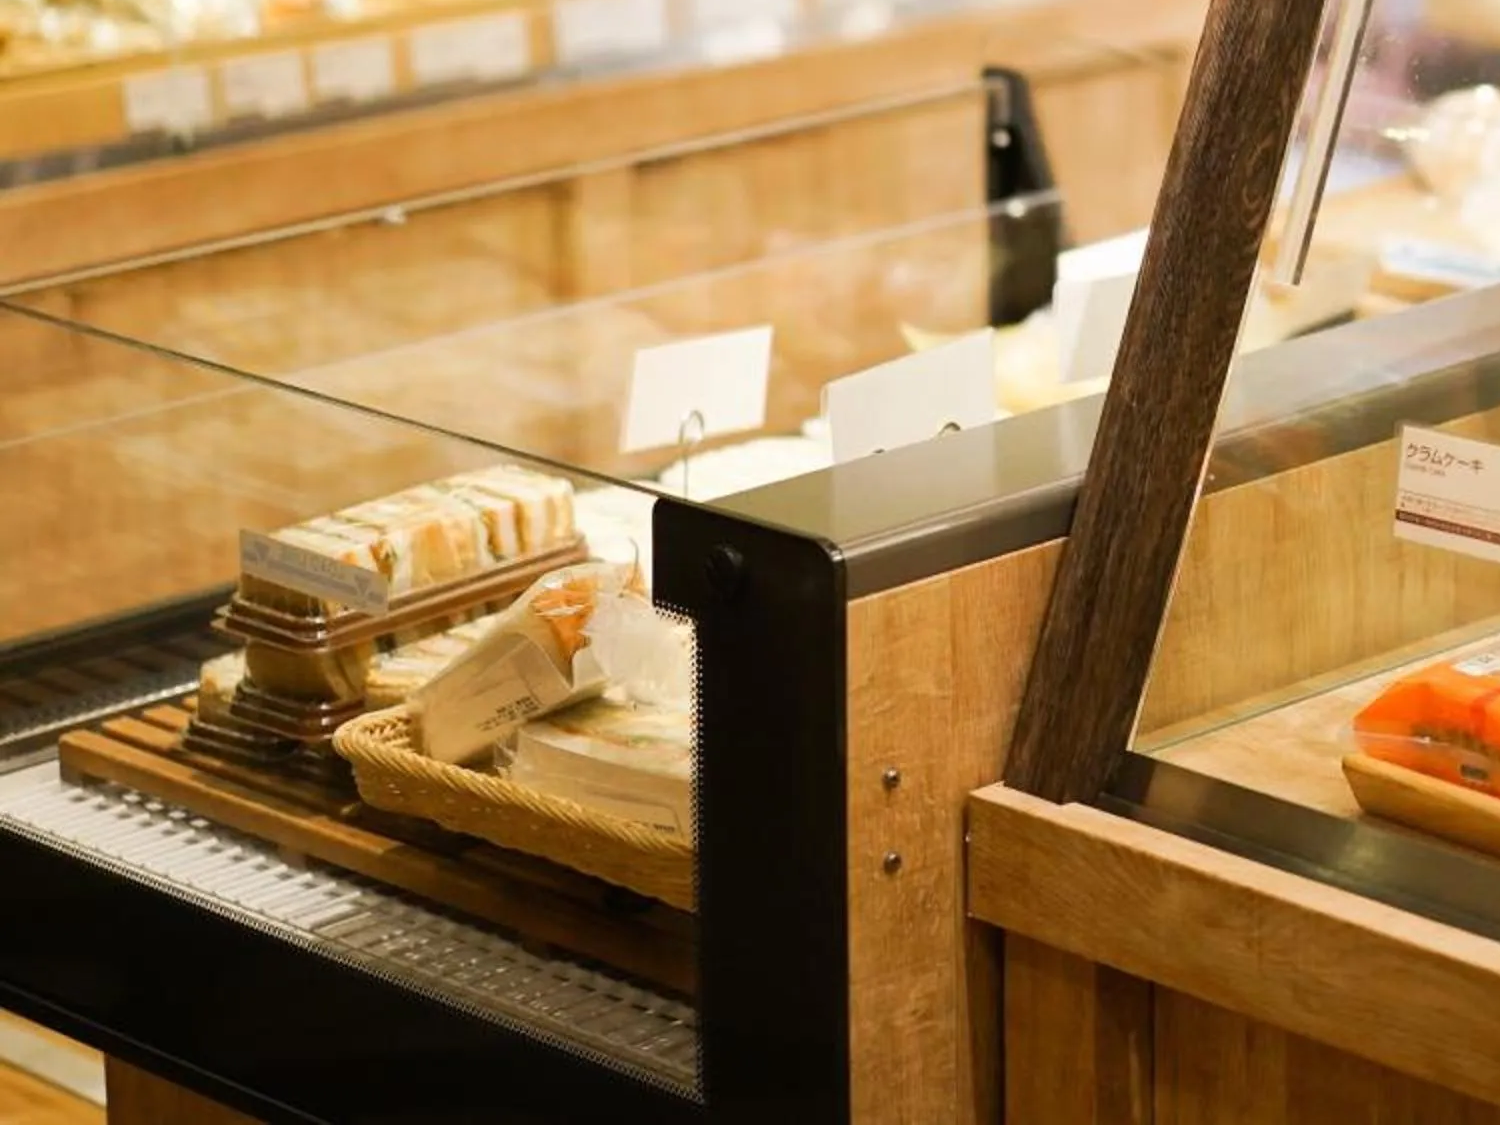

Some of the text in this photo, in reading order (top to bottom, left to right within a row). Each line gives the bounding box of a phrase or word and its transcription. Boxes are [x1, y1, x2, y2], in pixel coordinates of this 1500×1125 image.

[1407, 442, 1485, 475] クラムケーキ
